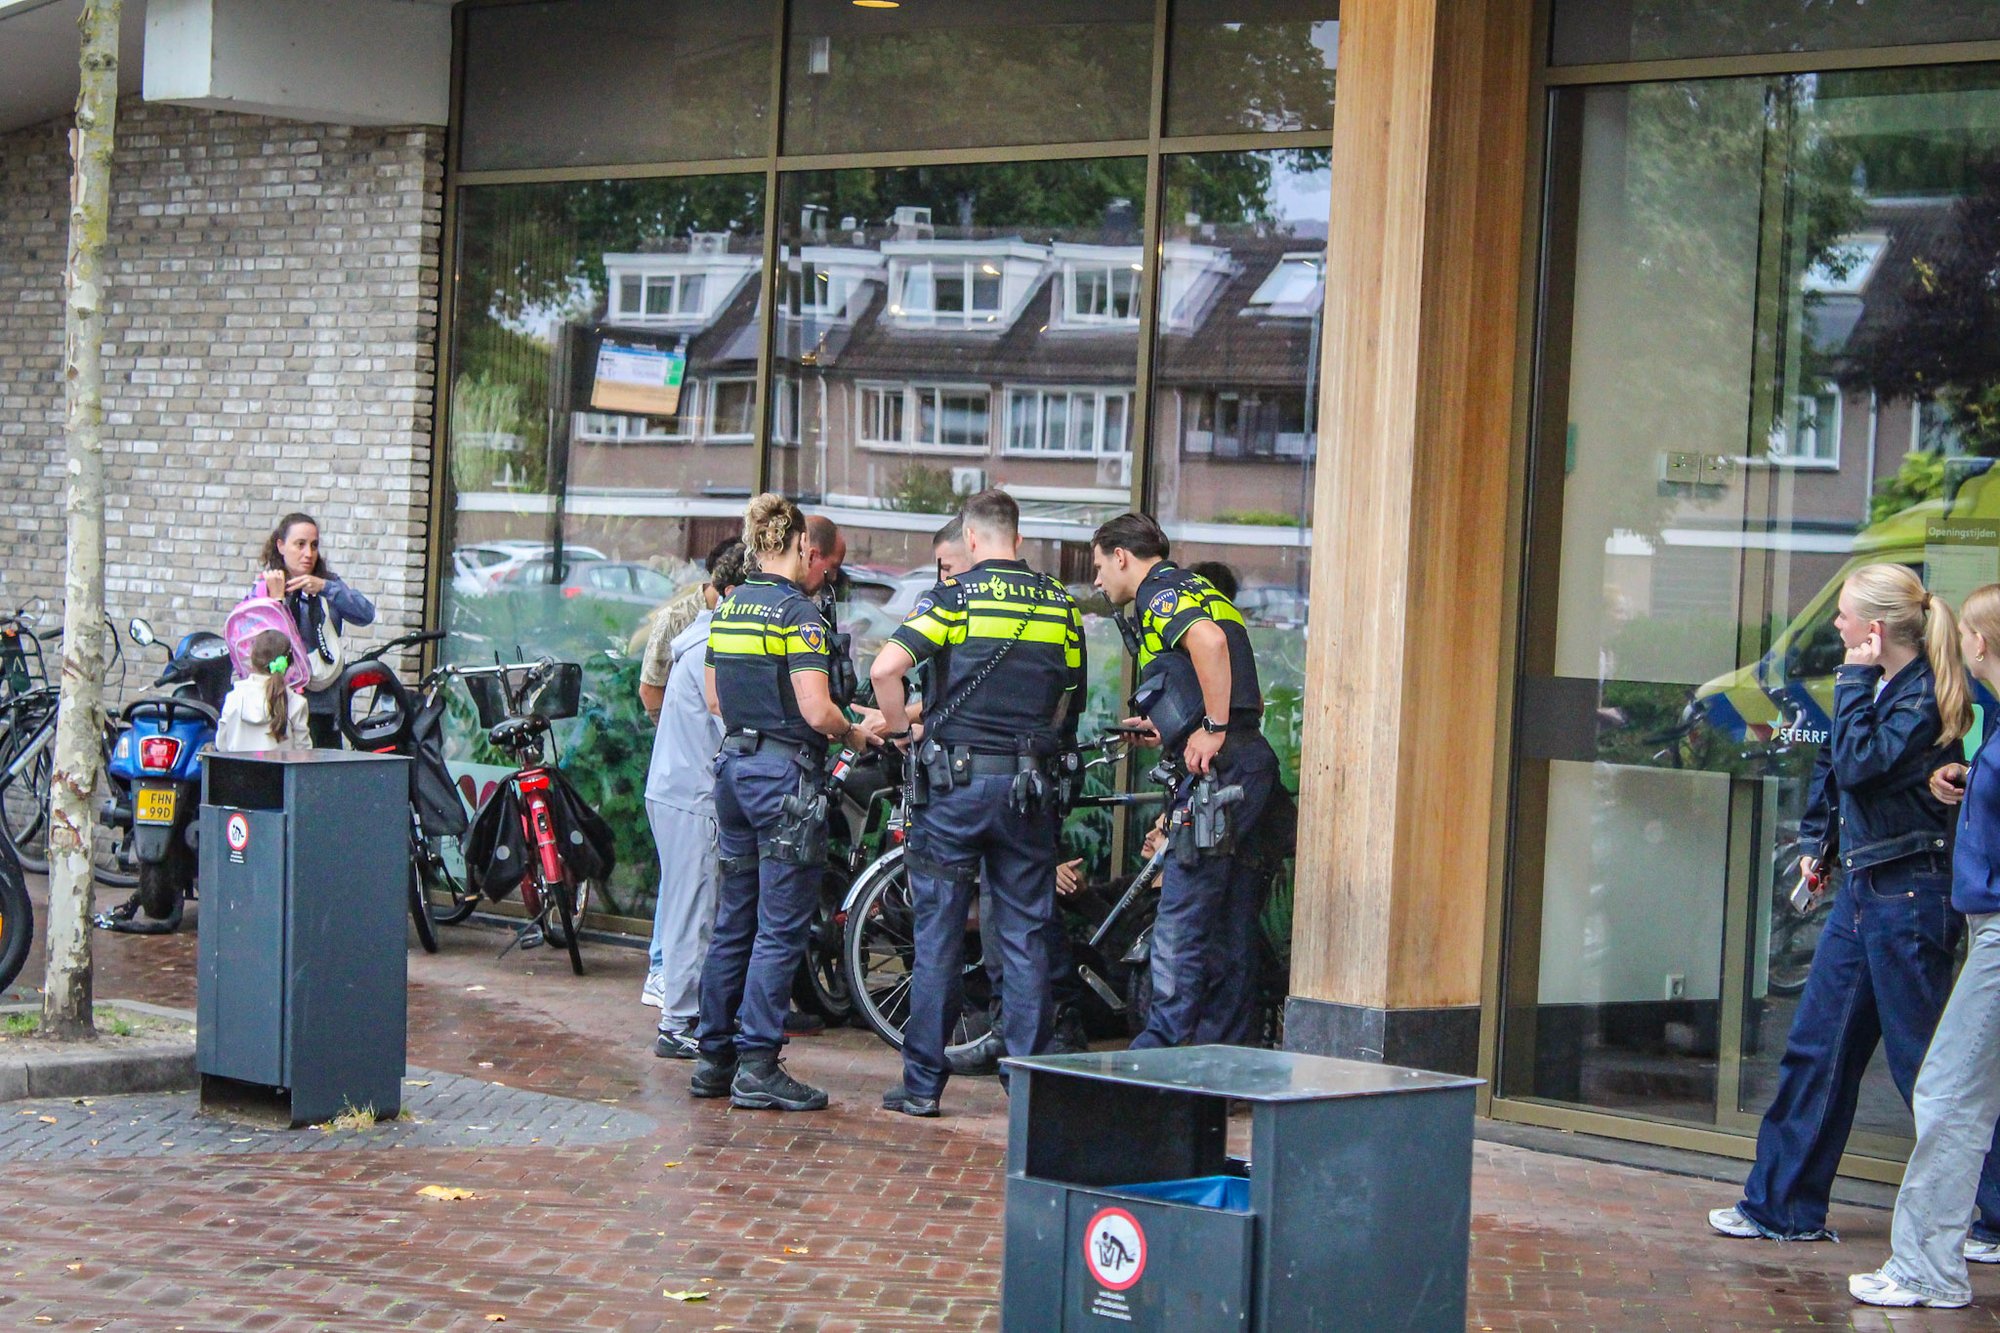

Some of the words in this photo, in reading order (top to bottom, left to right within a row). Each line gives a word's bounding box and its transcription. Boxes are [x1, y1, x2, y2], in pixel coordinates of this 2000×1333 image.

[1928, 527, 1997, 540] Openingstijden
[150, 793, 172, 805] FHN
[149, 806, 171, 818] 99D
